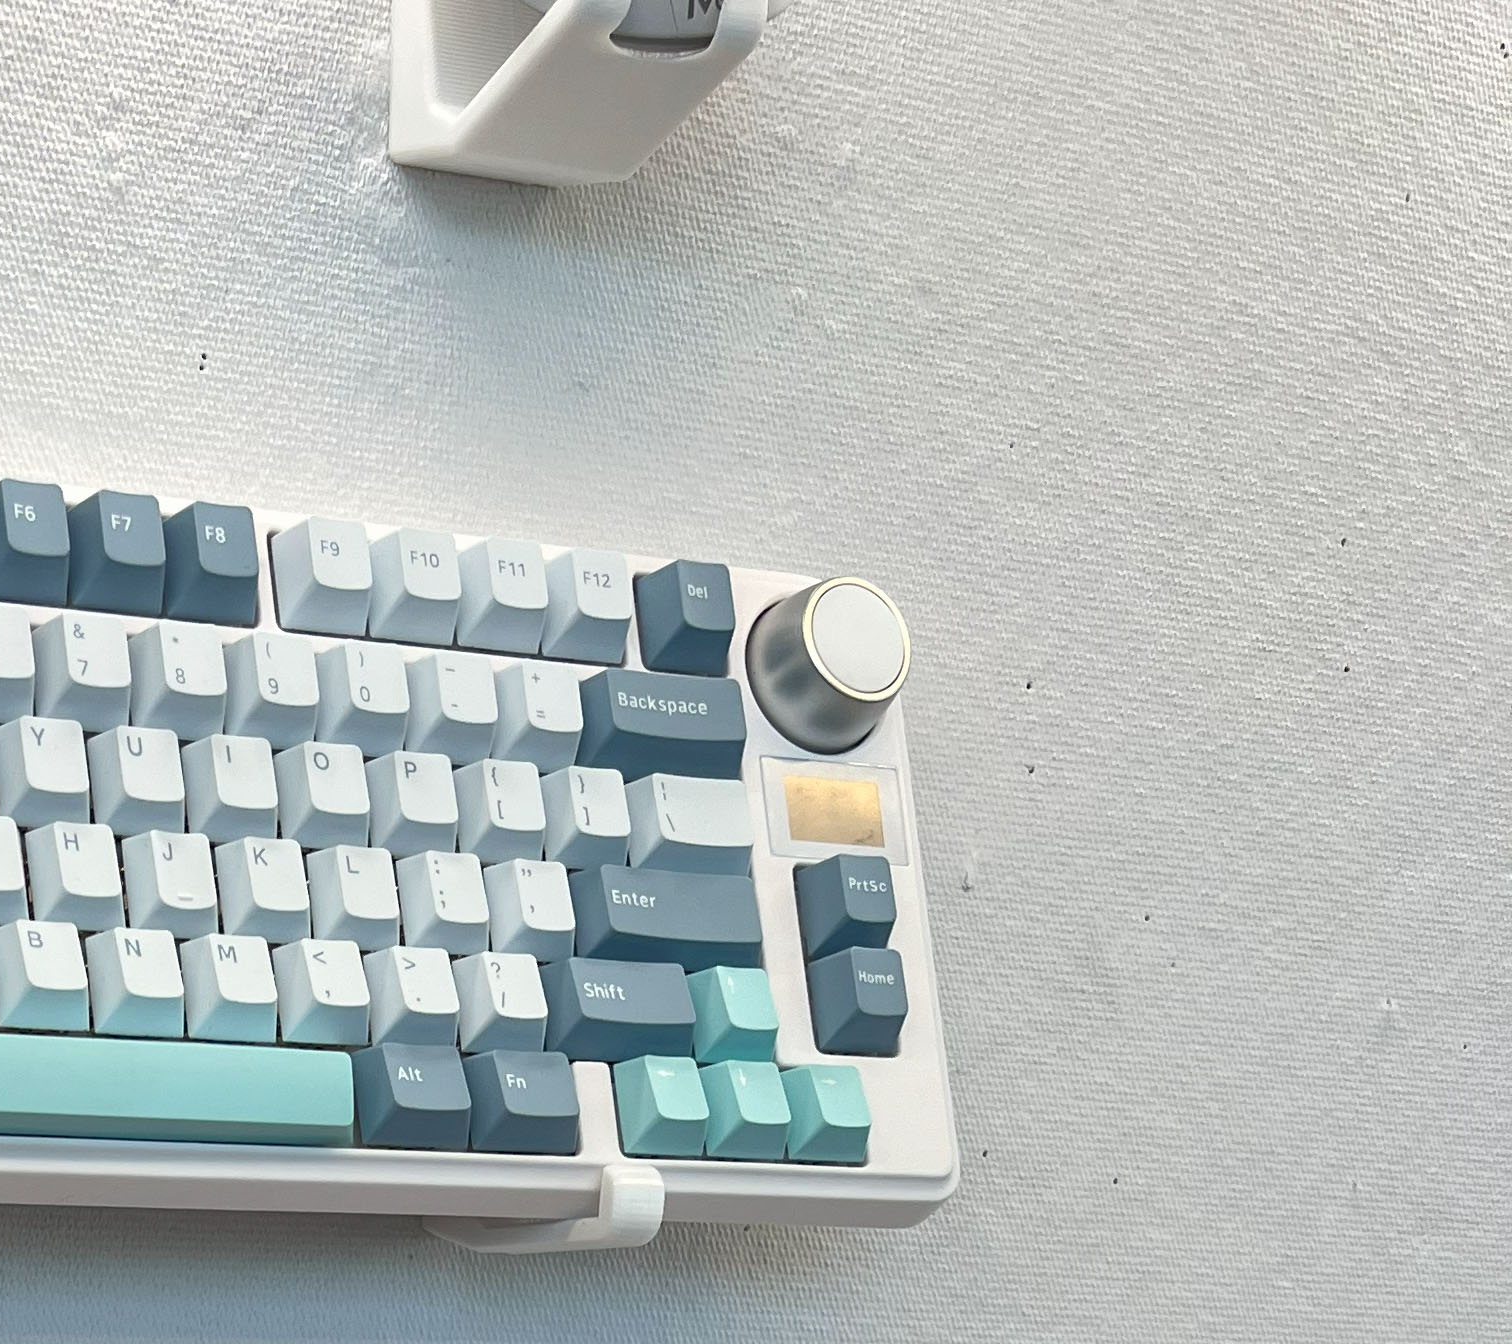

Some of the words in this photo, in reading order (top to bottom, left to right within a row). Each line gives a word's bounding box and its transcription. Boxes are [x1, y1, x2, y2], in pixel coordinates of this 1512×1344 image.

[14, 503, 36, 521] F6
[111, 514, 131, 531] F7
[205, 525, 226, 543] F8
[320, 540, 340, 557] F9
[410, 550, 439, 568] F10
[498, 560, 525, 577] F11
[583, 571, 611, 588] F12
[688, 584, 708, 599] Del
[73, 623, 85, 639] &
[264, 642, 272, 658] (
[77, 659, 88, 676] 7
[358, 651, 365, 667] )
[175, 668, 186, 684] 8
[268, 678, 279, 695] 9
[360, 686, 370, 702] 0
[618, 692, 707, 716] Backspace
[30, 726, 45, 746] Y
[126, 736, 142, 757] U
[225, 745, 232, 763] I
[313, 752, 329, 770] O
[404, 761, 417, 779] P
[63, 832, 79, 851] H
[163, 842, 173, 861] J
[253, 847, 268, 866] K
[346, 855, 360, 874] L
[849, 877, 887, 892] PrtSc
[612, 889, 656, 907] Enter
[27, 930, 43, 948] B
[124, 938, 142, 957] N
[217, 944, 237, 963] M
[312, 951, 326, 964] <
[402, 957, 416, 970] >
[490, 962, 501, 978] ?
[858, 970, 894, 985] Home
[584, 982, 625, 1000] Shift
[398, 1066, 423, 1082] Alt
[506, 1074, 526, 1089] Fn
